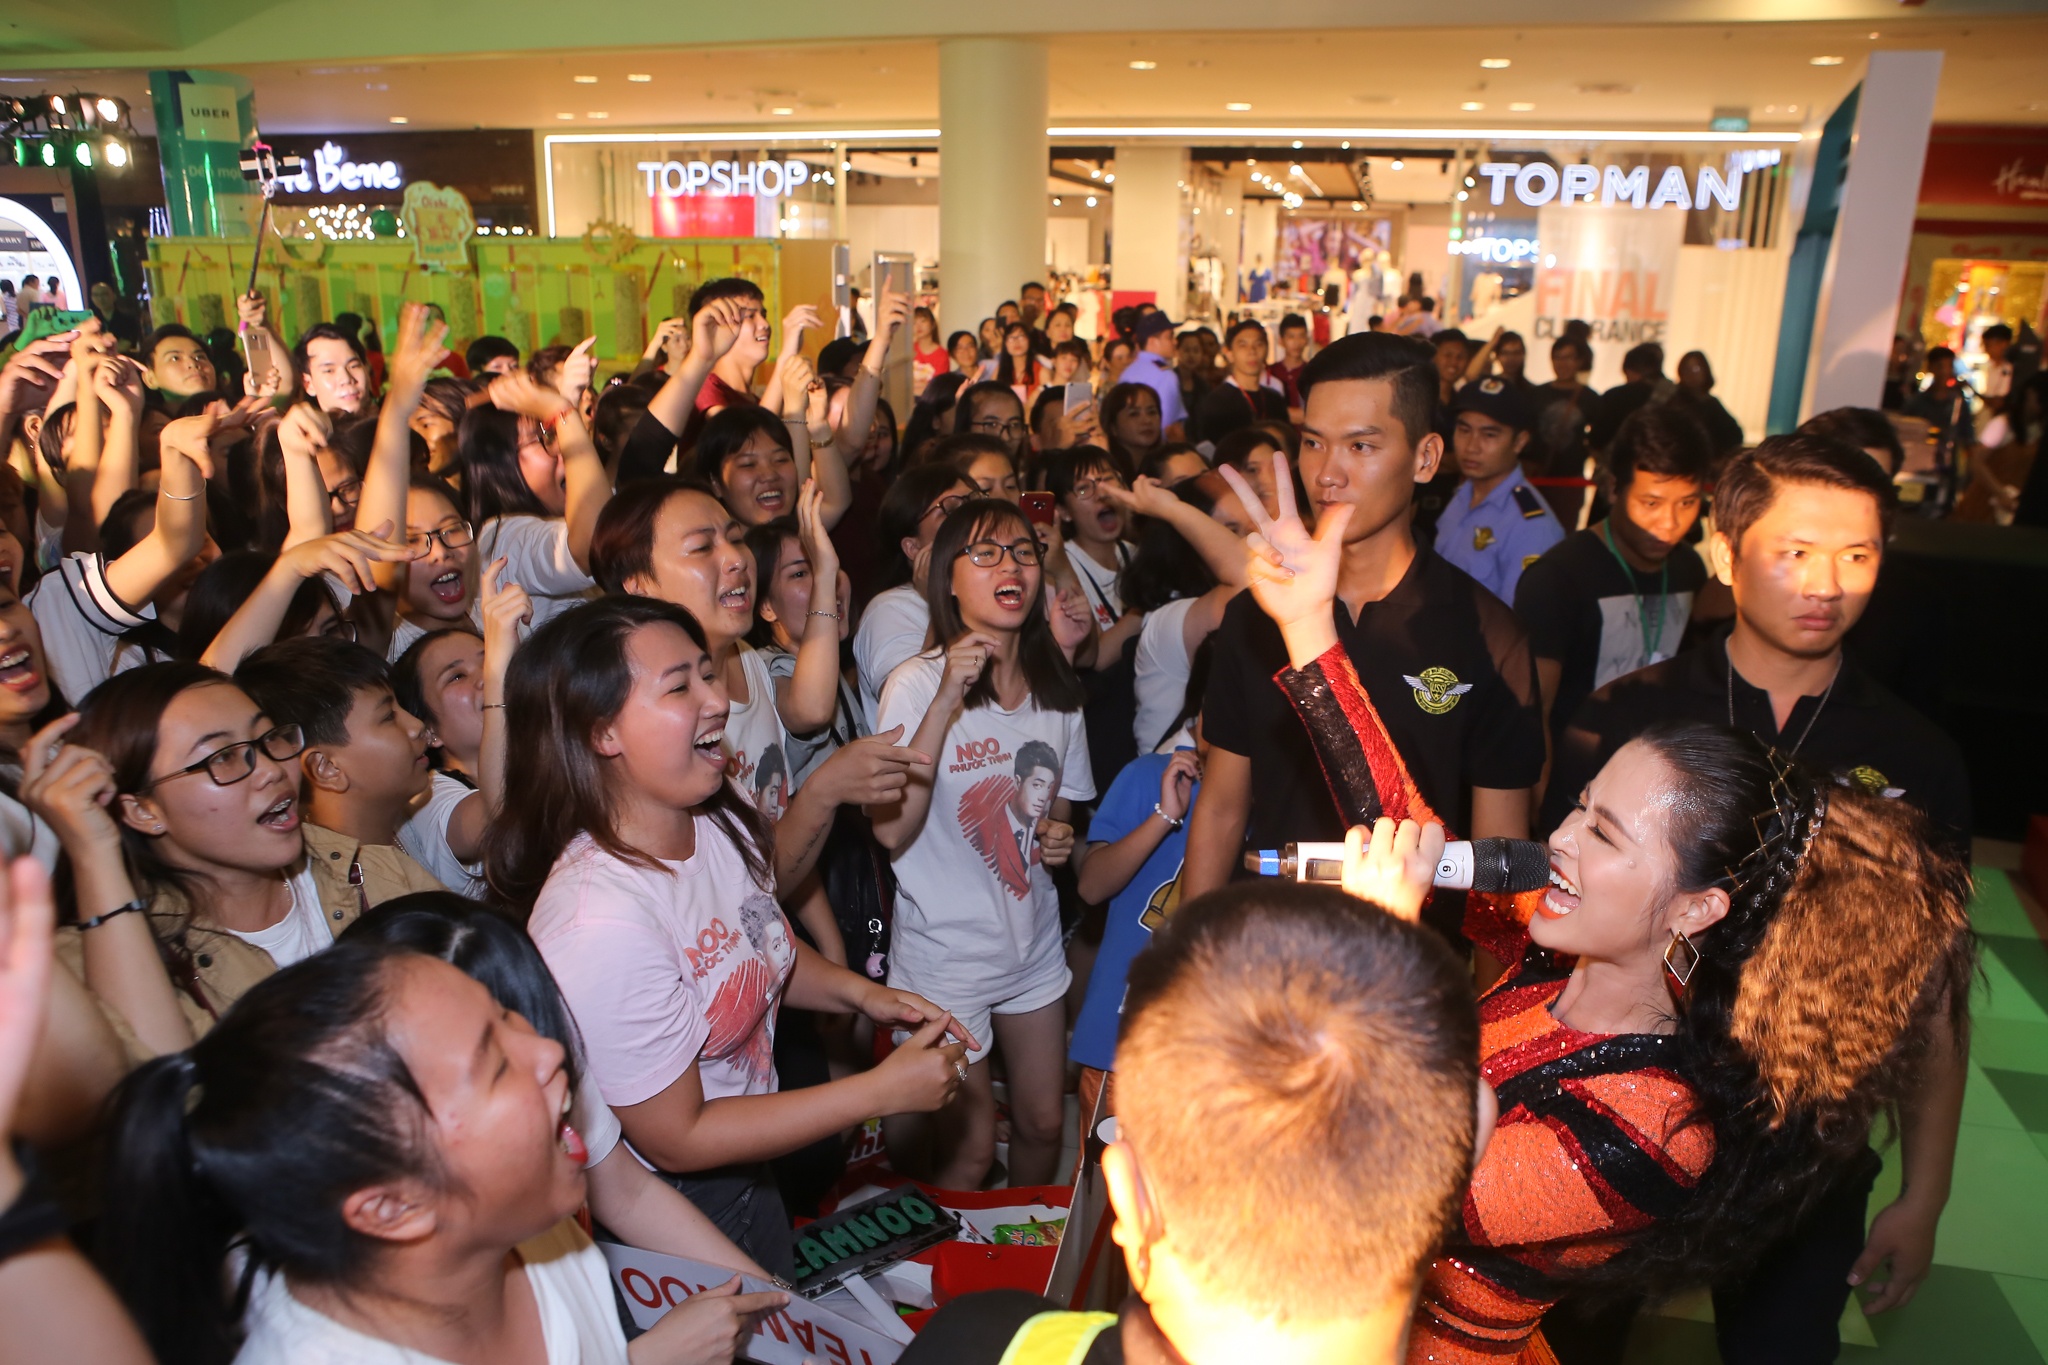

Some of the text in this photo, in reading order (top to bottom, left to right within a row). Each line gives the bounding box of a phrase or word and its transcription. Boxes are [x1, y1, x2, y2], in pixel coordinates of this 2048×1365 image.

[190, 107, 230, 119] UBER
[637, 160, 808, 197] TOPSHOP
[1479, 161, 1743, 211] TOPMAN
[1536, 269, 1669, 320] FINAL
[1534, 316, 1667, 345] CLRANCE
[956, 737, 1000, 763] NOO
[620, 1267, 709, 1310] OO
